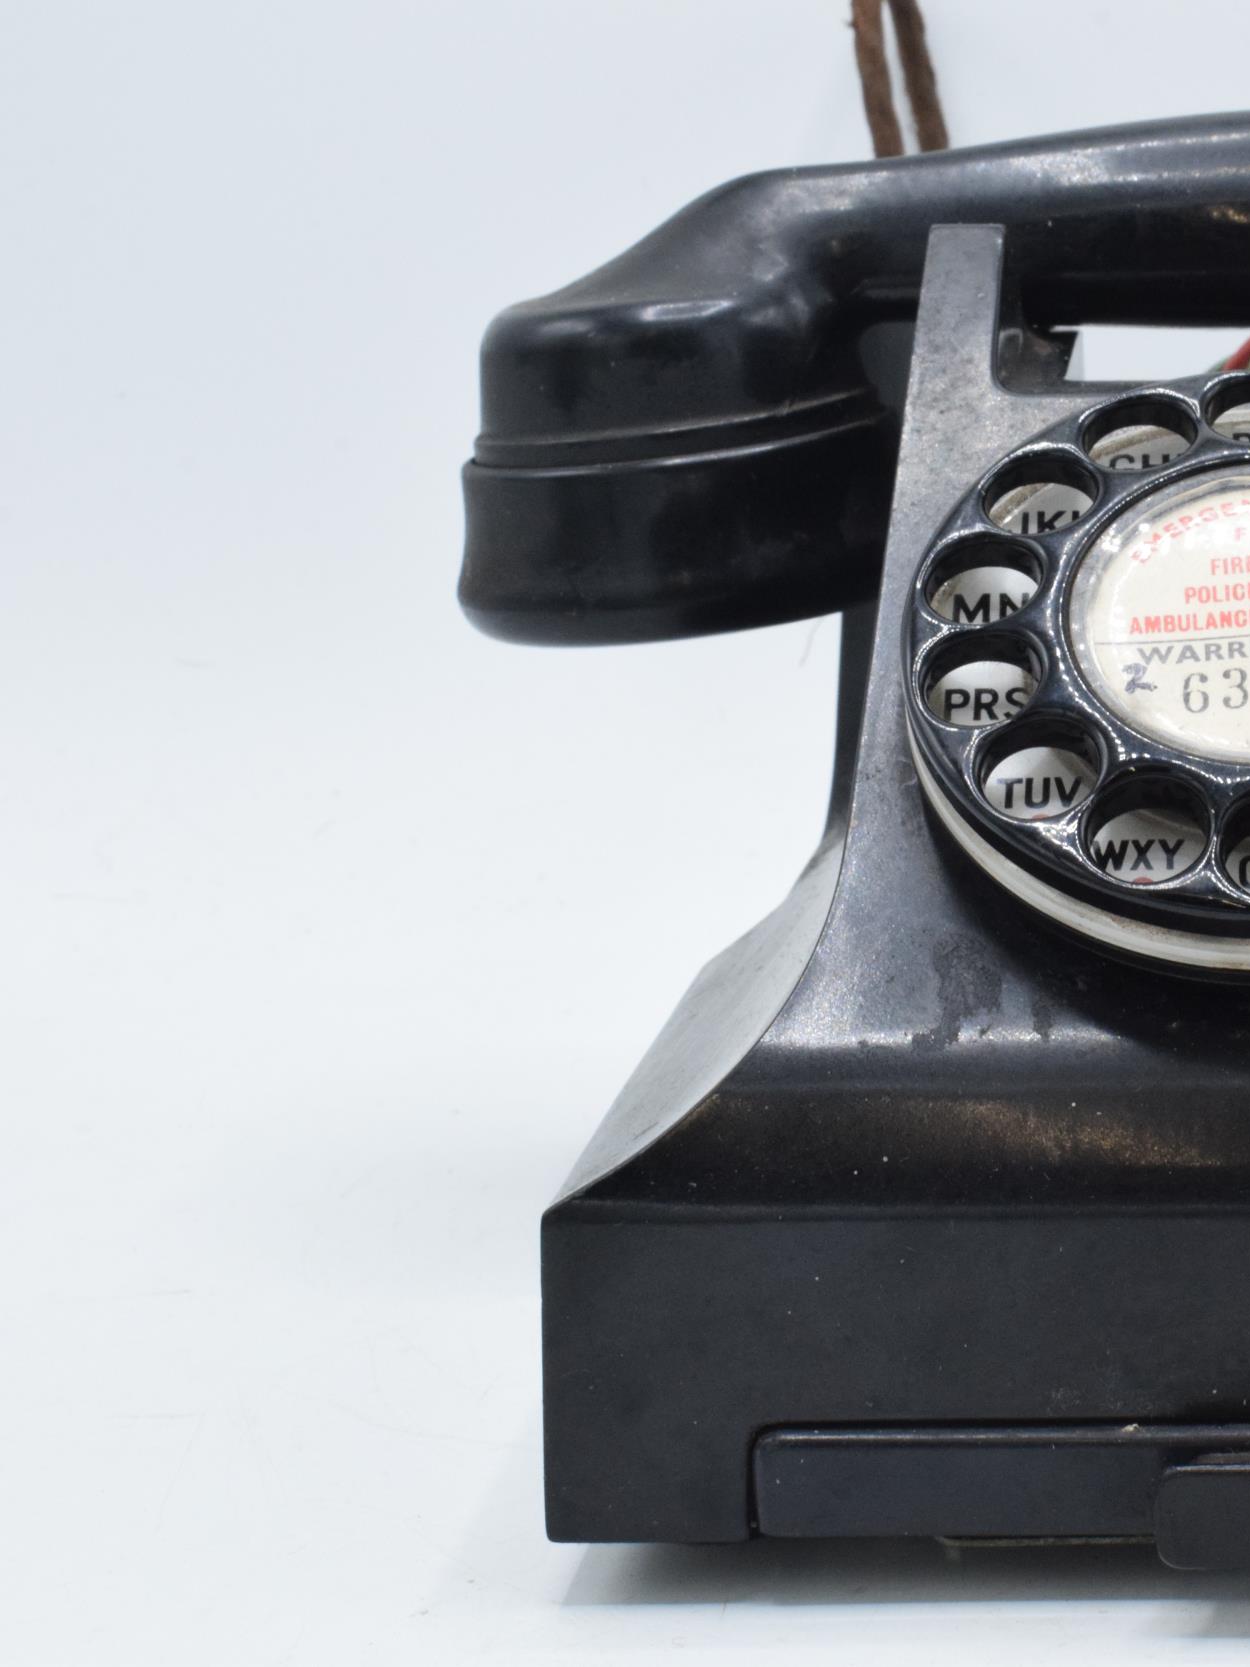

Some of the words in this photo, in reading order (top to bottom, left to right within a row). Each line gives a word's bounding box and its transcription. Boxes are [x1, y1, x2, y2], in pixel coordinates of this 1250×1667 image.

[953, 593, 1030, 623] MN
[943, 687, 1026, 721] PRS
[995, 776, 1083, 809] TUV
[1092, 838, 1185, 871] WXY
